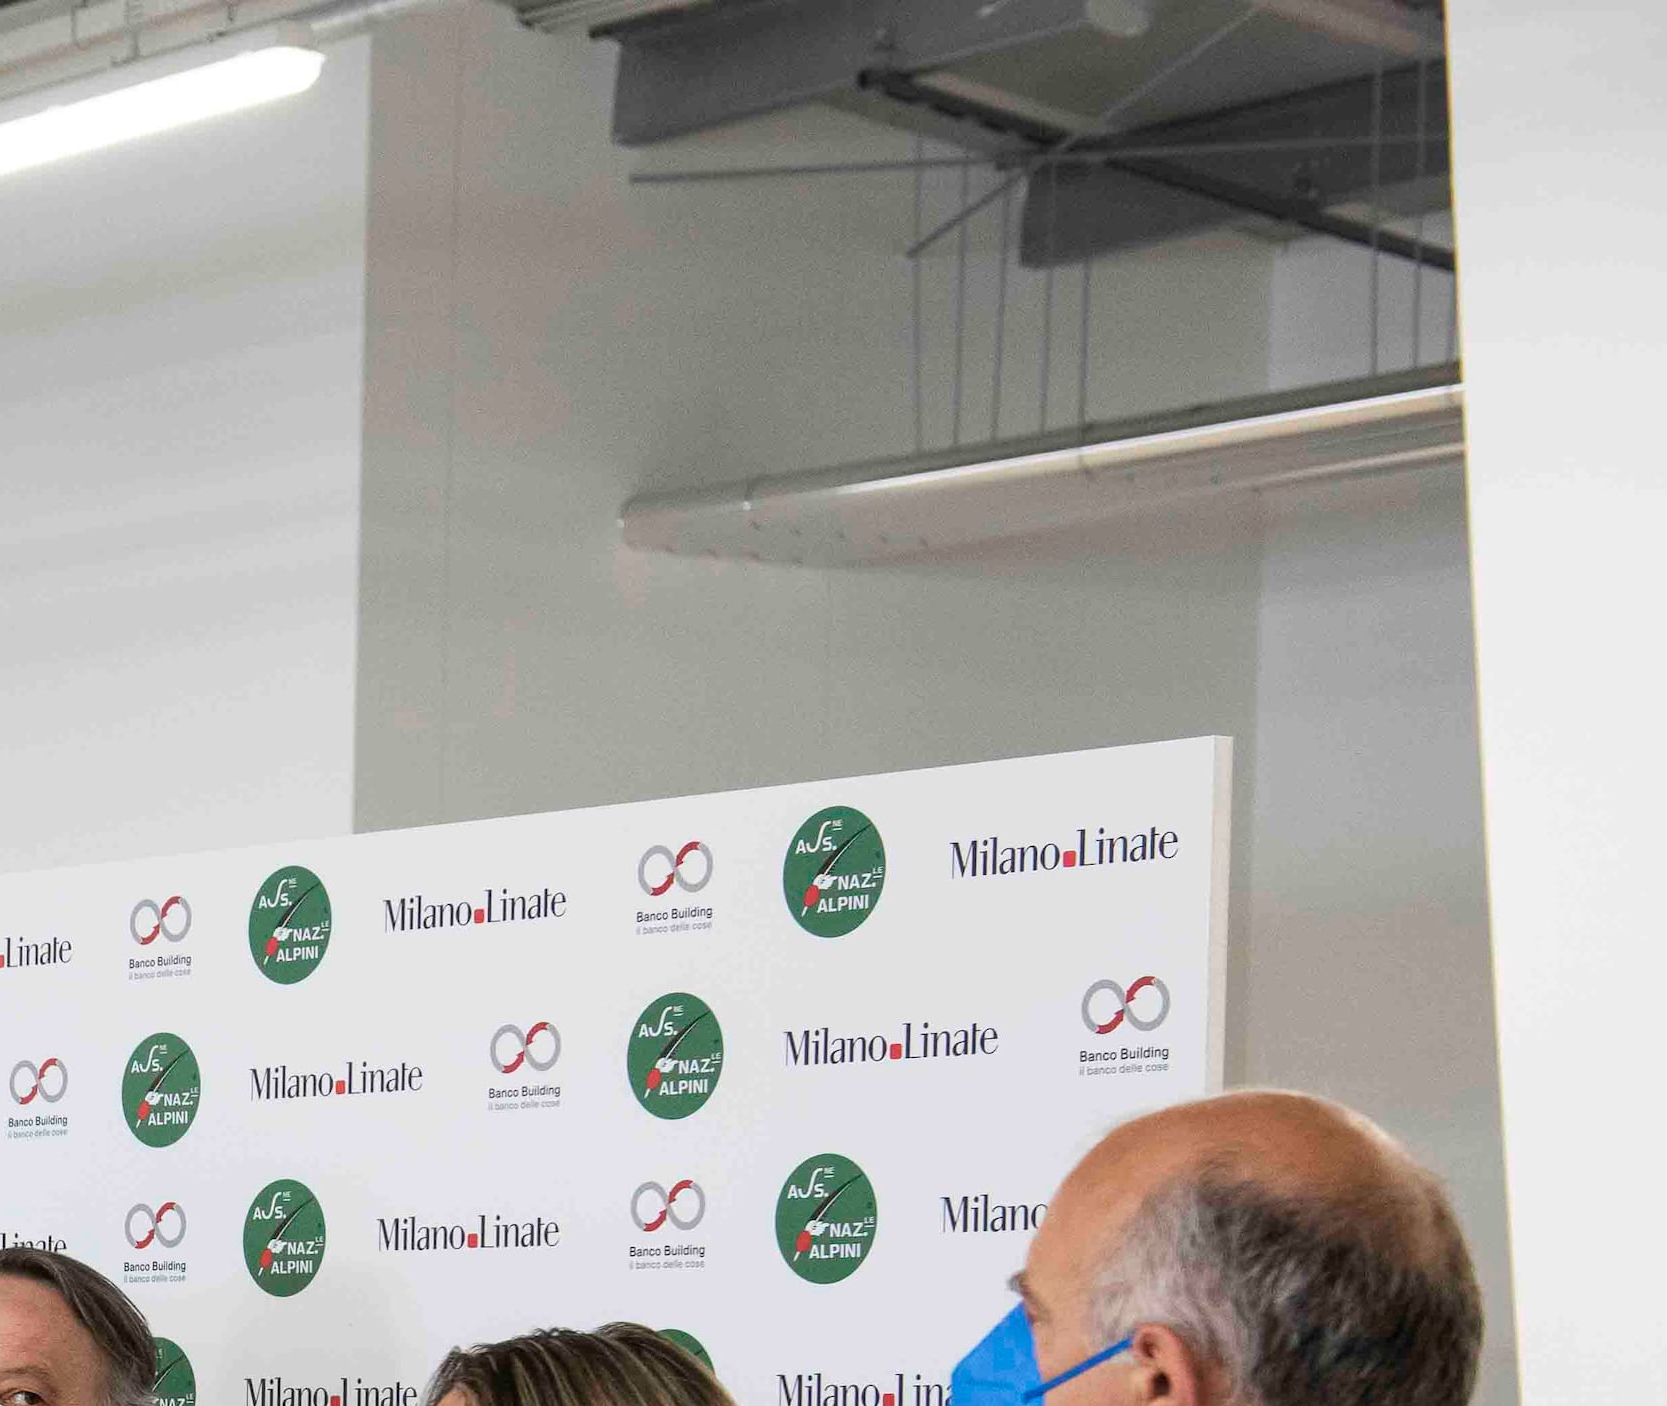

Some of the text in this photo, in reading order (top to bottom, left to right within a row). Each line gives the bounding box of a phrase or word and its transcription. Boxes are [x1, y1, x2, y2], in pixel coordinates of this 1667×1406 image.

[817, 894, 870, 914] ALPINI
[636, 907, 713, 923] Banco Building
[129, 955, 192, 969] Banco Building
[276, 946, 319, 962] ALPINI
[1080, 1047, 1169, 1062] Banco Building
[489, 1085, 561, 1099] Banco Building
[659, 1078, 708, 1096] ALPINI
[8, 1115, 68, 1128] Banco Building
[148, 1110, 188, 1126] ALPINI
[629, 1245, 705, 1258] Banco Building
[809, 1243, 861, 1259] ALPINI
[124, 1260, 186, 1273] Banco Building
[270, 1259, 313, 1275] ALPINI
